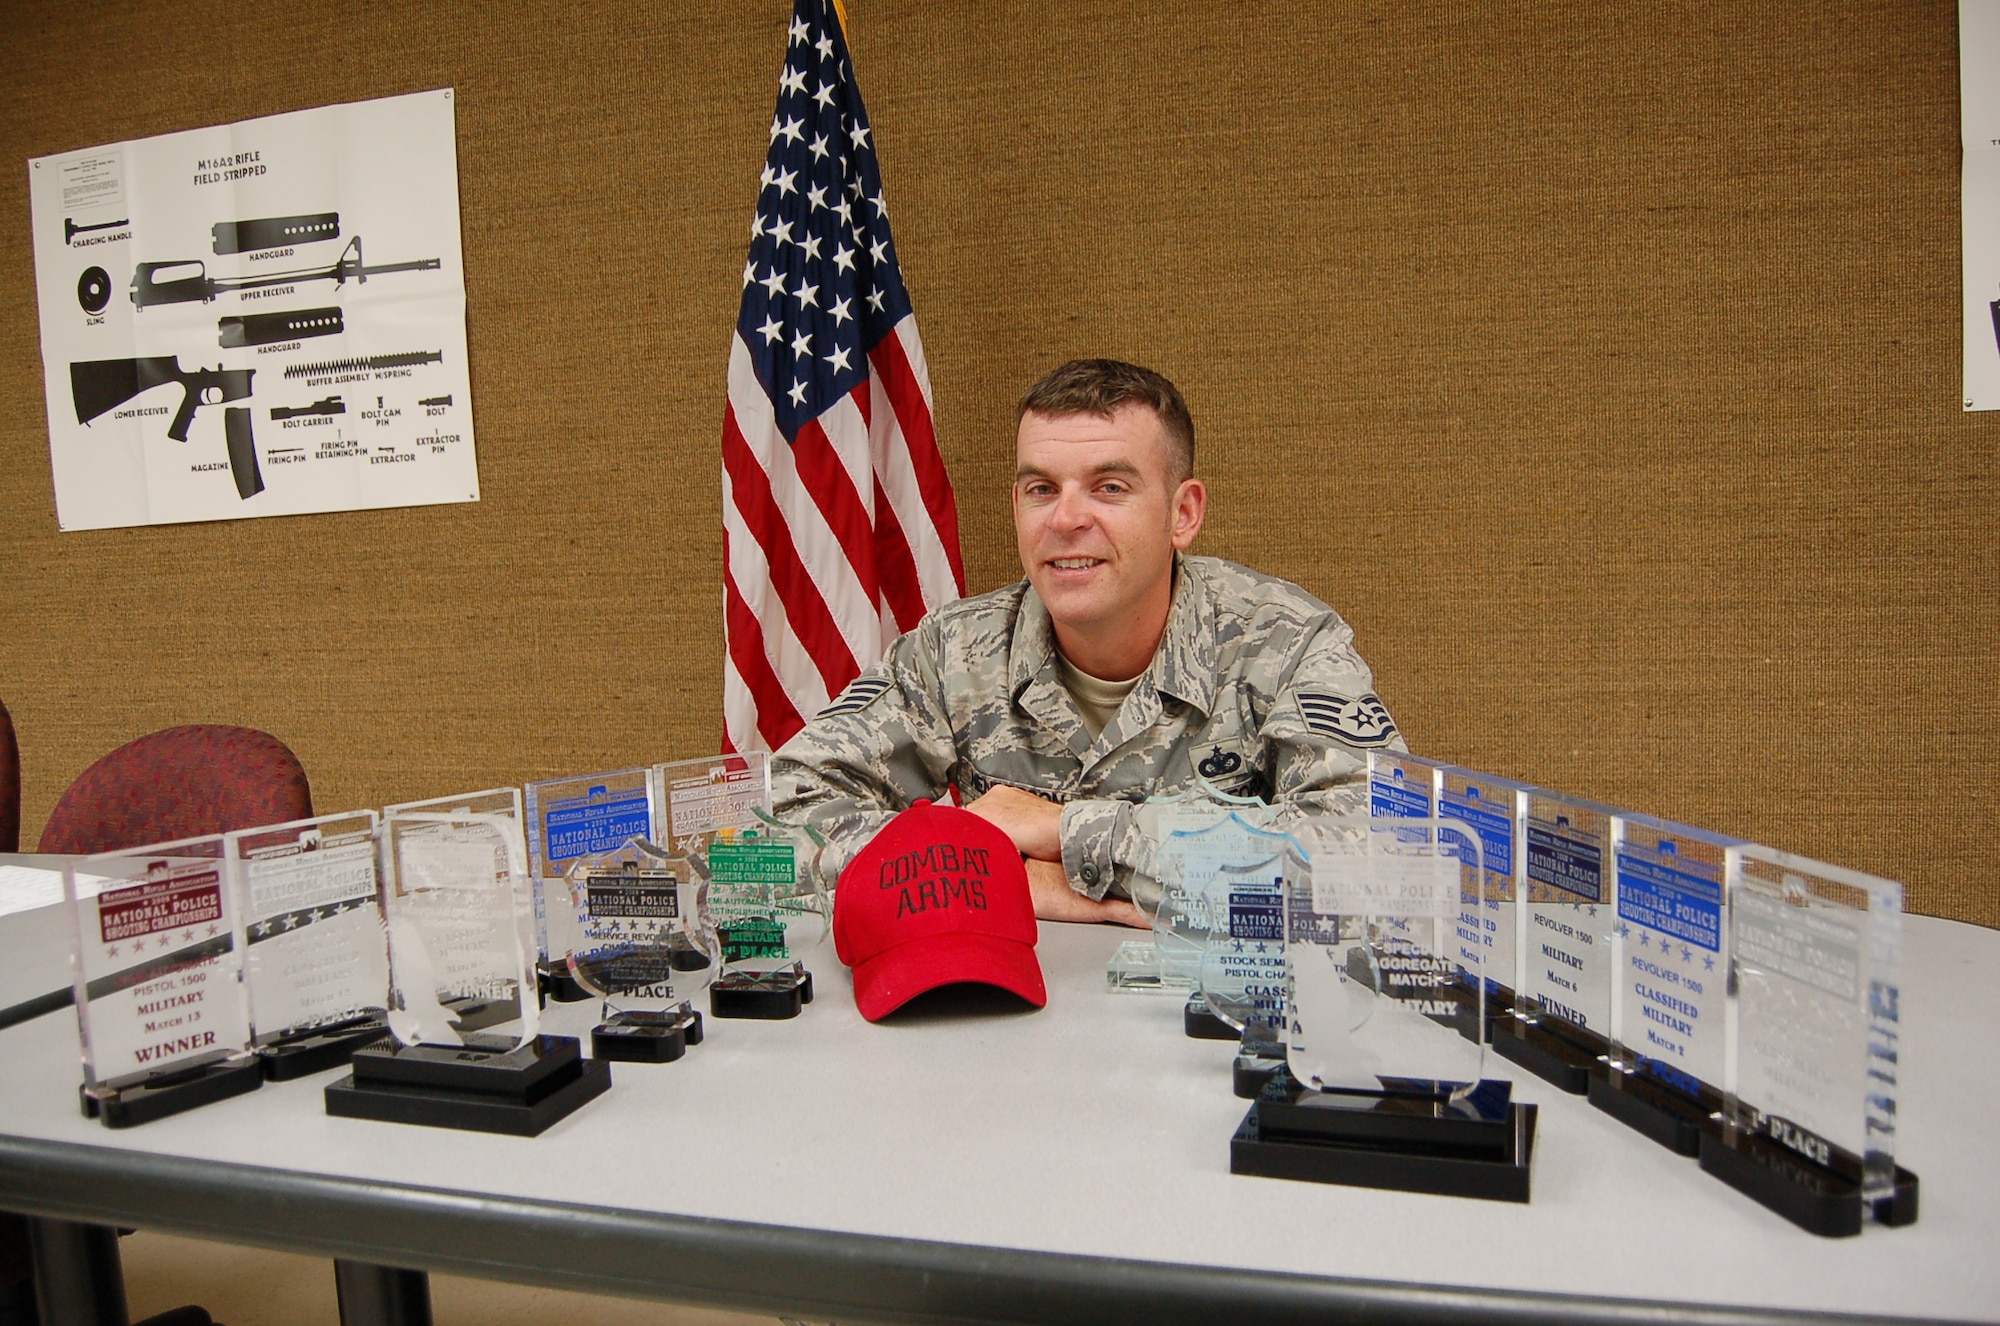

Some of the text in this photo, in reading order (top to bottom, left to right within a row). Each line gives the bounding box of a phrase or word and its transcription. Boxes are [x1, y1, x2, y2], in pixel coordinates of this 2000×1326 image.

[198, 151, 261, 171] M16A2 RIFLE
[194, 165, 267, 186] FIELD STRIPPED
[73, 232, 133, 248] CHARGING HANDLE
[249, 248, 295, 261] HANDGUARD
[240, 286, 295, 301] UPPER RECEIVER
[86, 317, 105, 326] SLING
[257, 342, 301, 355] HANDGUARD
[307, 369, 412, 387] BUFFER ASSEMBLY W/SPRING
[114, 407, 169, 419] LOWER RECEIVER
[361, 408, 401, 419] BOLT CAM
[426, 407, 446, 416] BOLT
[283, 417, 333, 429] BOLT CARRIER
[376, 418, 389, 427] PIN
[321, 440, 358, 450] FIRING PIN
[416, 434, 461, 446] EXTRACTOR
[315, 448, 368, 459] RETAINING PIN
[432, 446, 445, 454] PIN
[268, 455, 306, 465] FIRING PIN
[370, 454, 415, 464] EXTRACTOR
[191, 462, 229, 472] MAGAZINE
[551, 820, 647, 846] NATIONAL POLICE
[552, 841, 589, 858] SHOOTING
[1483, 839, 1508, 858] OLICE
[711, 862, 792, 872] NATIONAL POLICE
[879, 843, 992, 890] COMBAT
[1528, 851, 1598, 884] NATIONAL POLICE
[896, 876, 987, 919] ARMS
[1400, 885, 1455, 899] POLIE
[590, 895, 675, 906] NATIONAL POLICE
[1619, 884, 1672, 914] NATIONAL
[1675, 902, 1717, 931] POLICE
[103, 893, 218, 928] NATIONAL POLICE
[1620, 900, 1656, 926] SHOOTING
[105, 906, 219, 941] SHOOTING CHAMPIONSHIPS
[1232, 914, 1283, 926] NATIONA
[1534, 912, 1593, 945] REVOLVER 1500
[728, 932, 782, 943] MILITARY
[740, 945, 790, 959] PLACE
[1541, 943, 1584, 971] MILITARY
[1220, 956, 1257, 966] STOCK
[1225, 968, 1262, 978] PISTOL
[1389, 973, 1439, 987] MATCH
[1632, 956, 1703, 995] REVOLVER 1500
[134, 972, 206, 997] PISTOL 1500
[1572, 982, 1578, 993] 6
[623, 985, 674, 999] PLACE
[137, 990, 205, 1017] MILITARY
[1634, 982, 1698, 1019] CLASSIFIED
[1537, 992, 1587, 1030] WINNER
[1642, 1004, 1693, 1037] MILITARY
[134, 1031, 216, 1063] WINNER
[1770, 1117, 1829, 1167] PLACE
